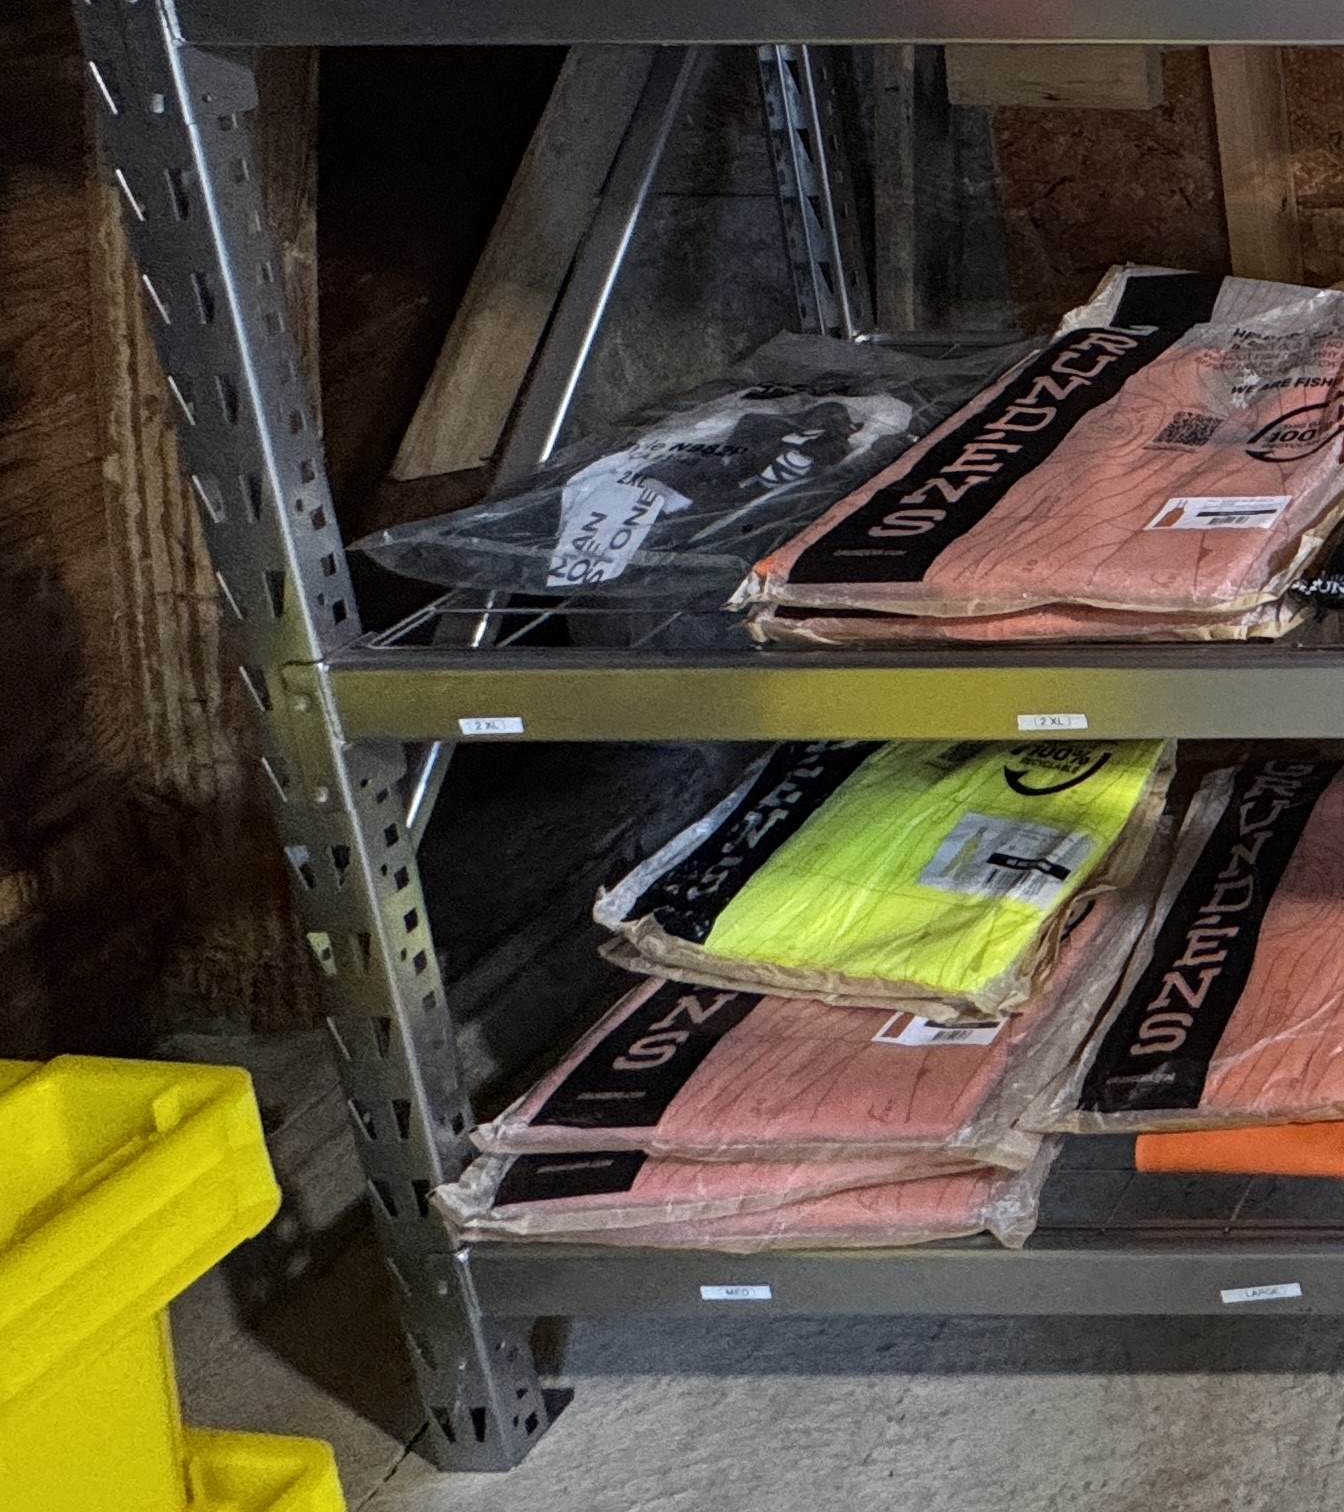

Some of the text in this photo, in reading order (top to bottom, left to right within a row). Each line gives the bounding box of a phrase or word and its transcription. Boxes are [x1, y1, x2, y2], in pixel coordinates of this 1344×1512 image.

[1262, 378, 1291, 393] ARE
[1294, 375, 1344, 388] FISHI
[1040, 716, 1065, 726] 2 XL
